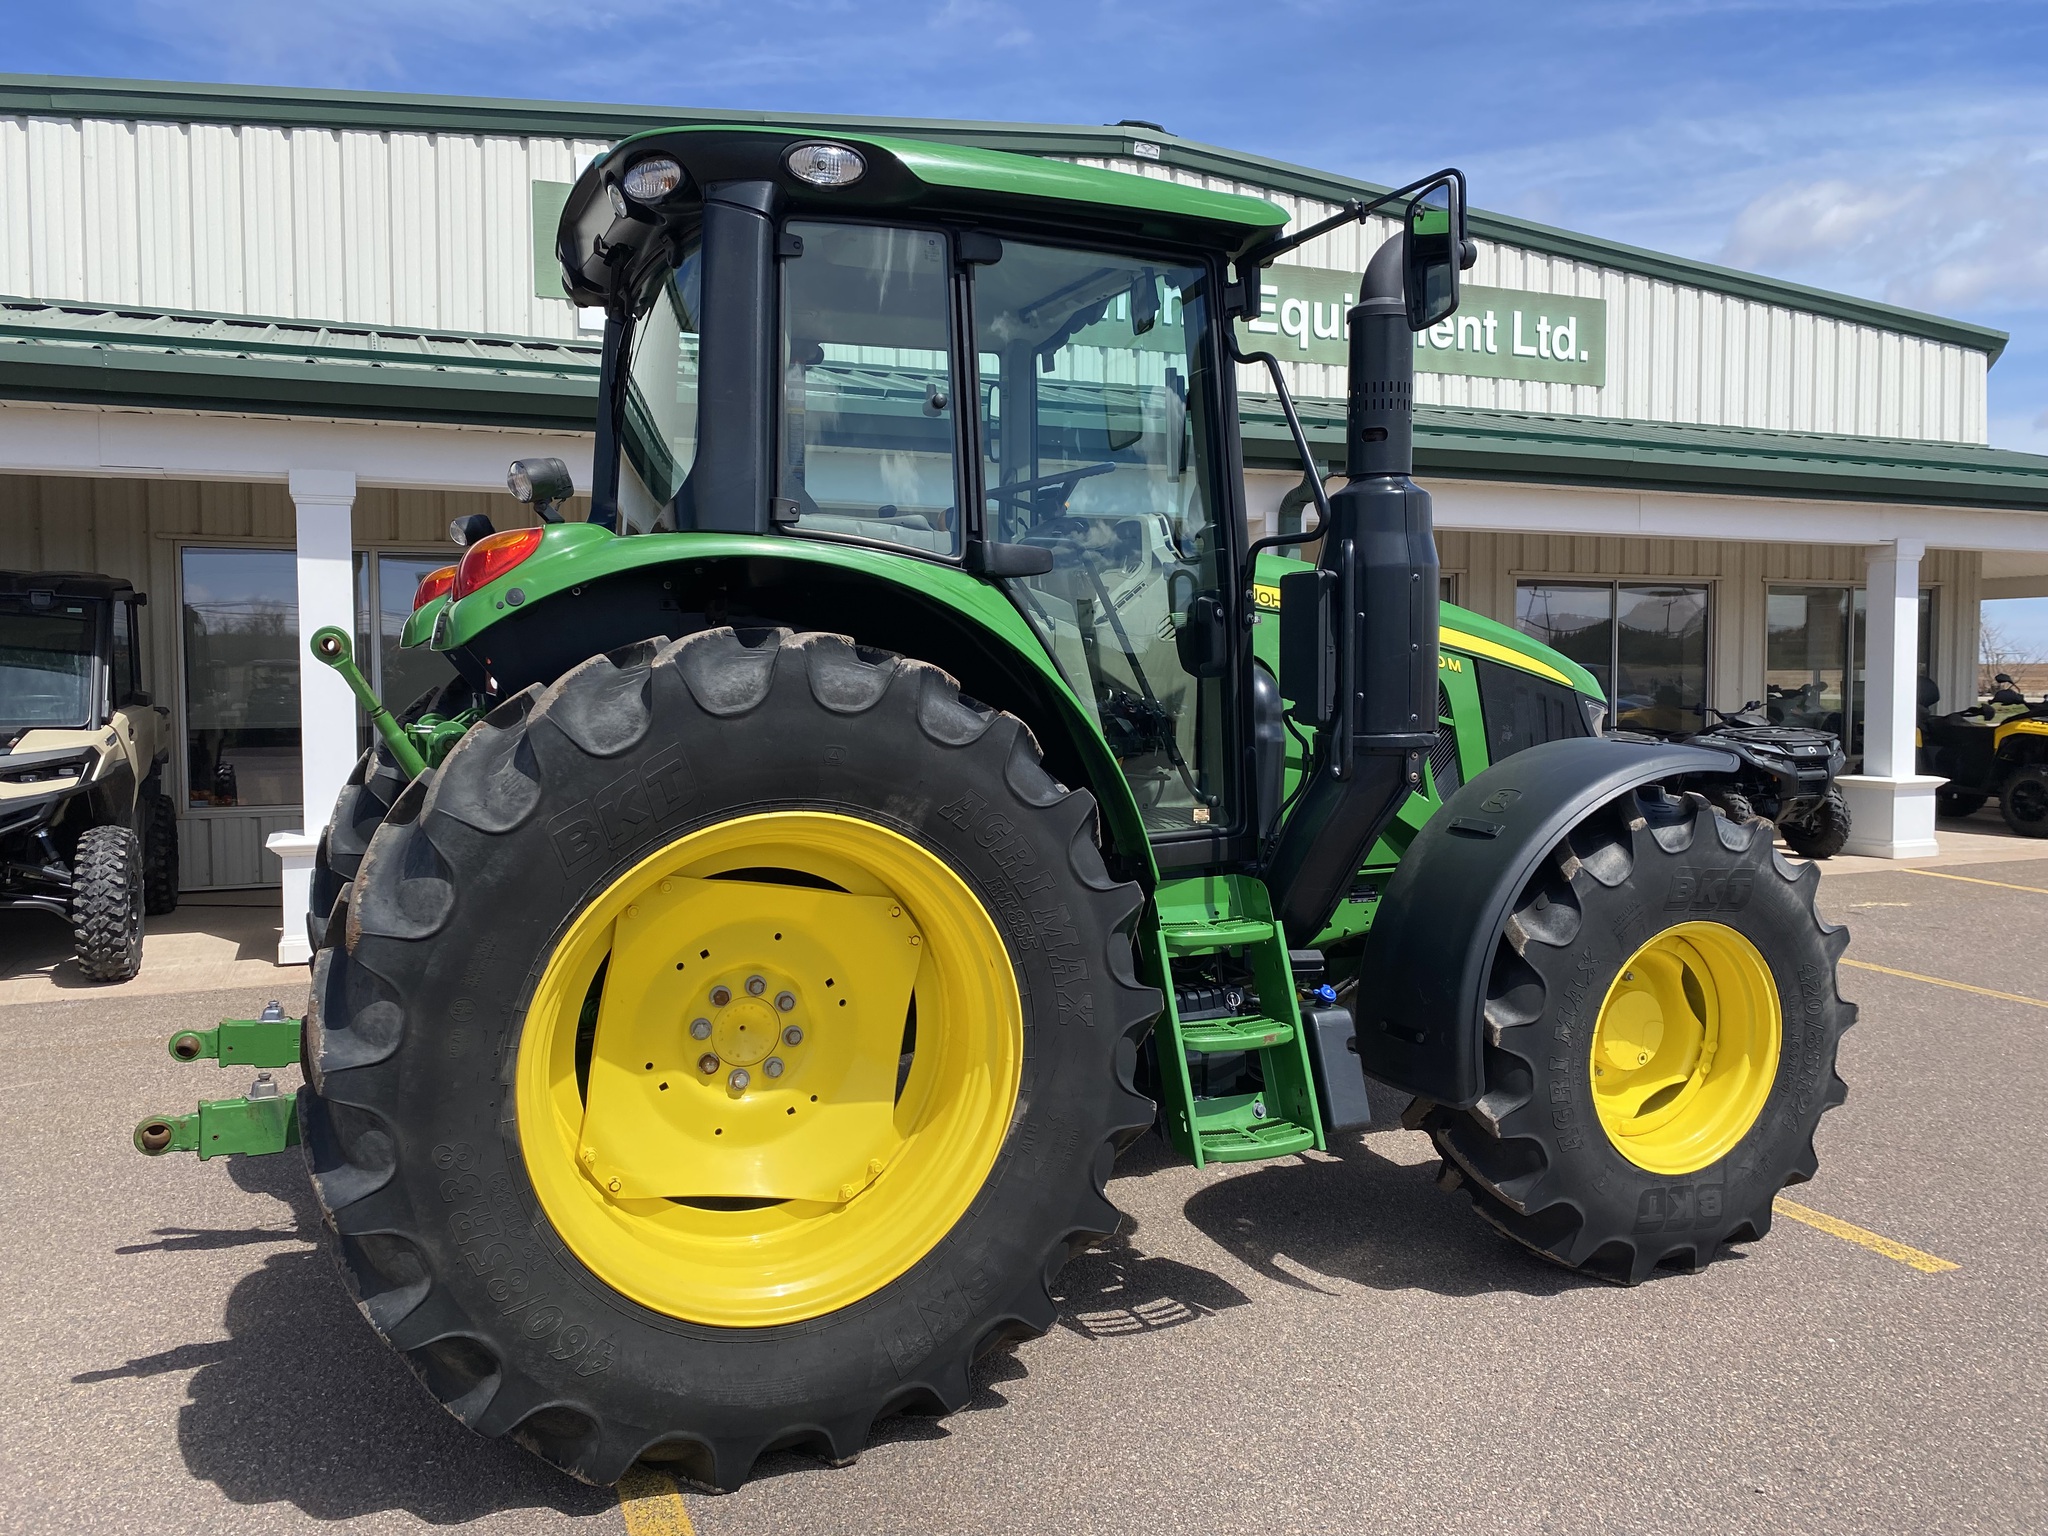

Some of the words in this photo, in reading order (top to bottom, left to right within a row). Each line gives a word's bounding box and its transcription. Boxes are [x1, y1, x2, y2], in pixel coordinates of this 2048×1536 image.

[1248, 285, 1498, 354] Equient
[1512, 310, 1589, 363] Ltd.
[1254, 588, 1281, 606] JOH
[549, 753, 688, 872] BKT
[1668, 870, 1754, 907] BKT
[1635, 1186, 1723, 1228] BKT
[887, 1252, 1000, 1374] BKT
